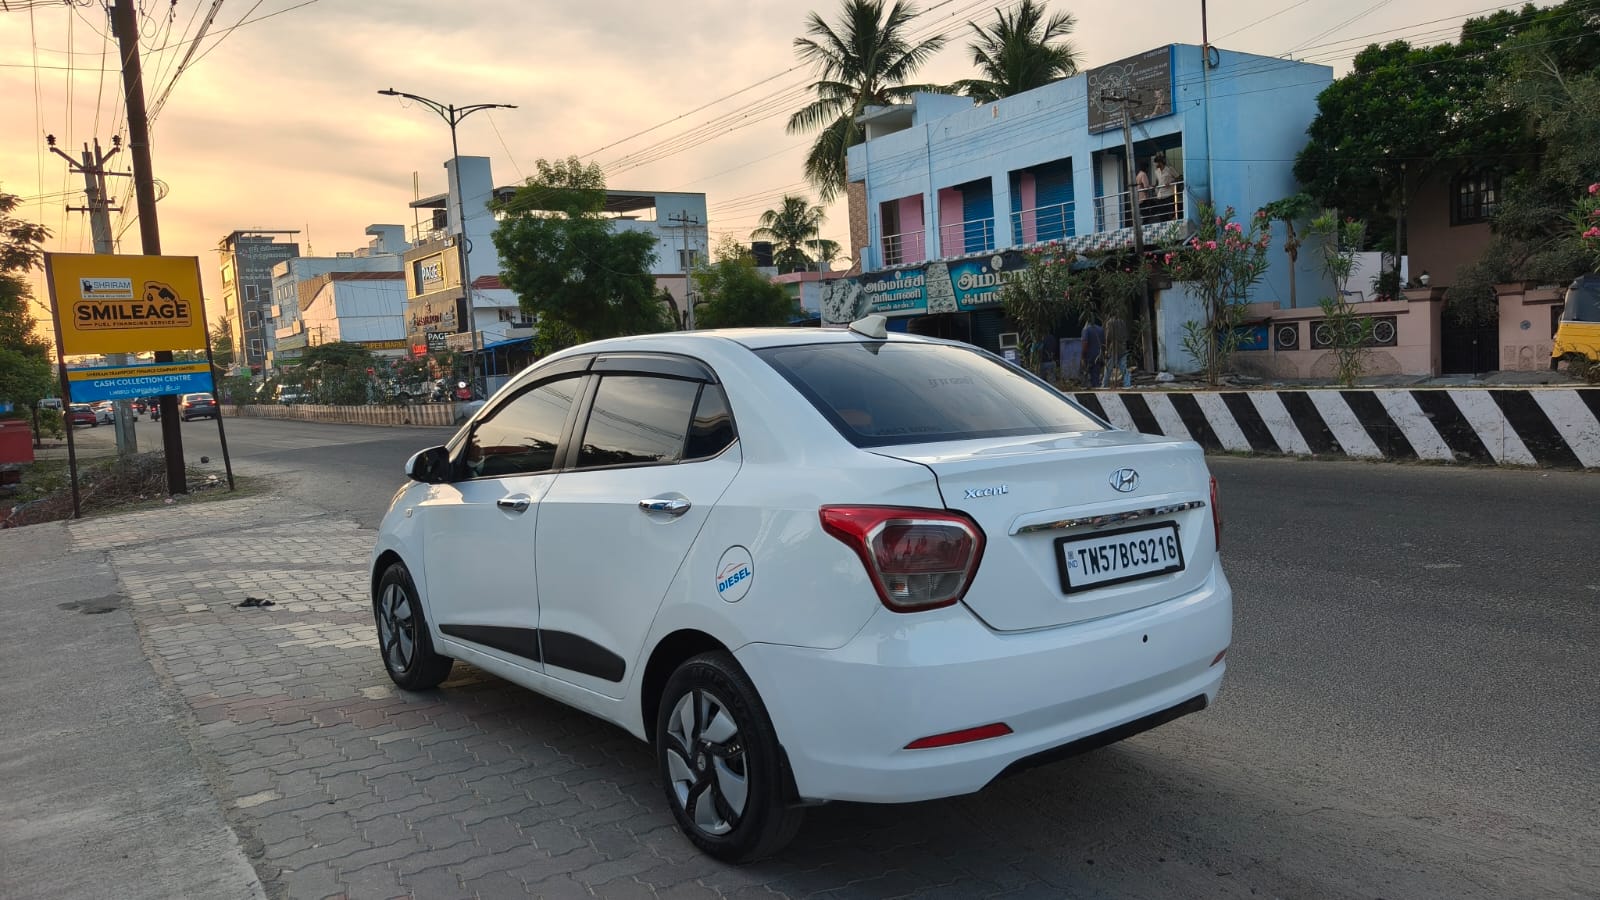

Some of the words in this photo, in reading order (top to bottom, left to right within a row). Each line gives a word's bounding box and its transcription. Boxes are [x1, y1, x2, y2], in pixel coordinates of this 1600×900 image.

[93, 281, 131, 289] SHRIRAM
[77, 303, 189, 320] SMILEAGE
[94, 379, 115, 388] CASH
[116, 377, 163, 387] COLLECTION
[164, 374, 192, 383] CENTRE
[1078, 535, 1177, 576] TN57BC9216
[718, 567, 751, 593] DIESEL
